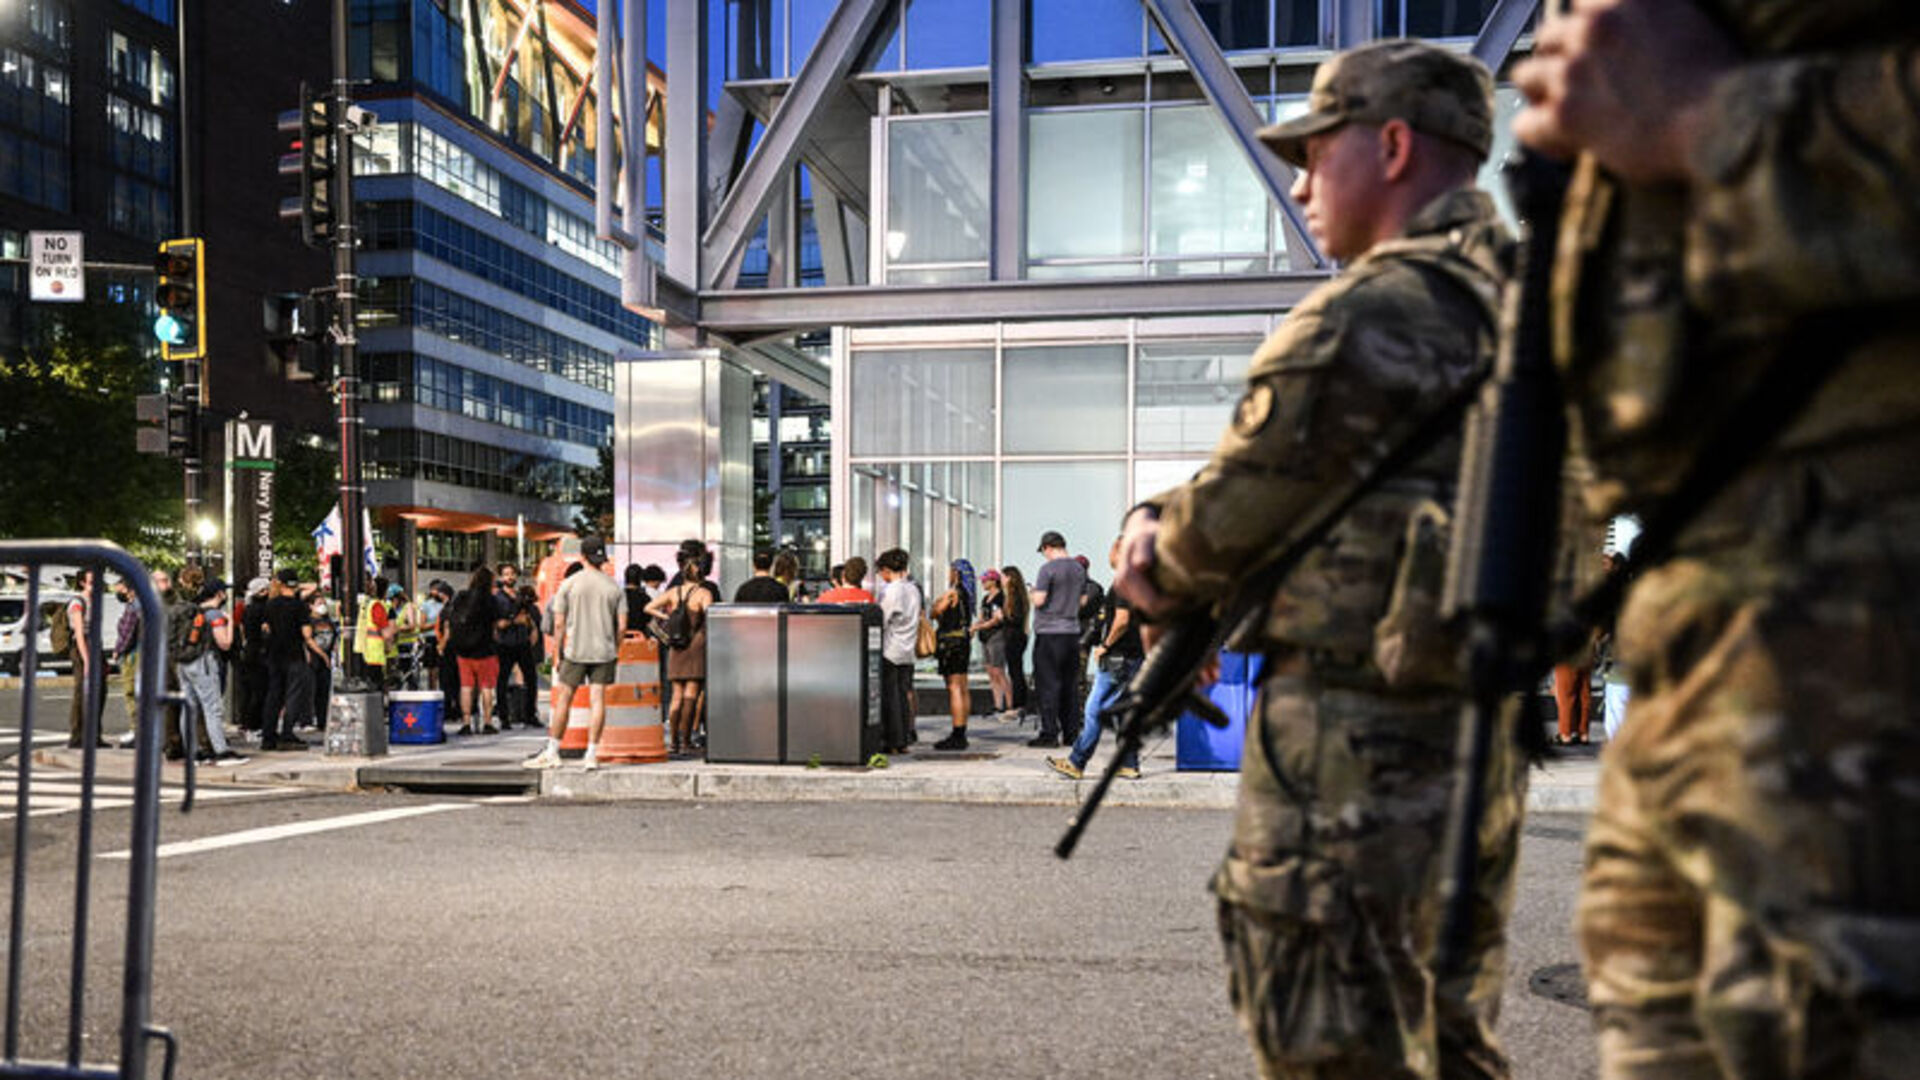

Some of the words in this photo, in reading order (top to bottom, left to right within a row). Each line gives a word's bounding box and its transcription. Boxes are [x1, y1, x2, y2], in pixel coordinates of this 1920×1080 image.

[44, 237, 68, 250] NO
[42, 253, 72, 265] TURN
[36, 266, 51, 277] ON
[236, 423, 273, 459] M
[256, 471, 274, 508] Navy
[258, 511, 273, 578] Yard-Ball
